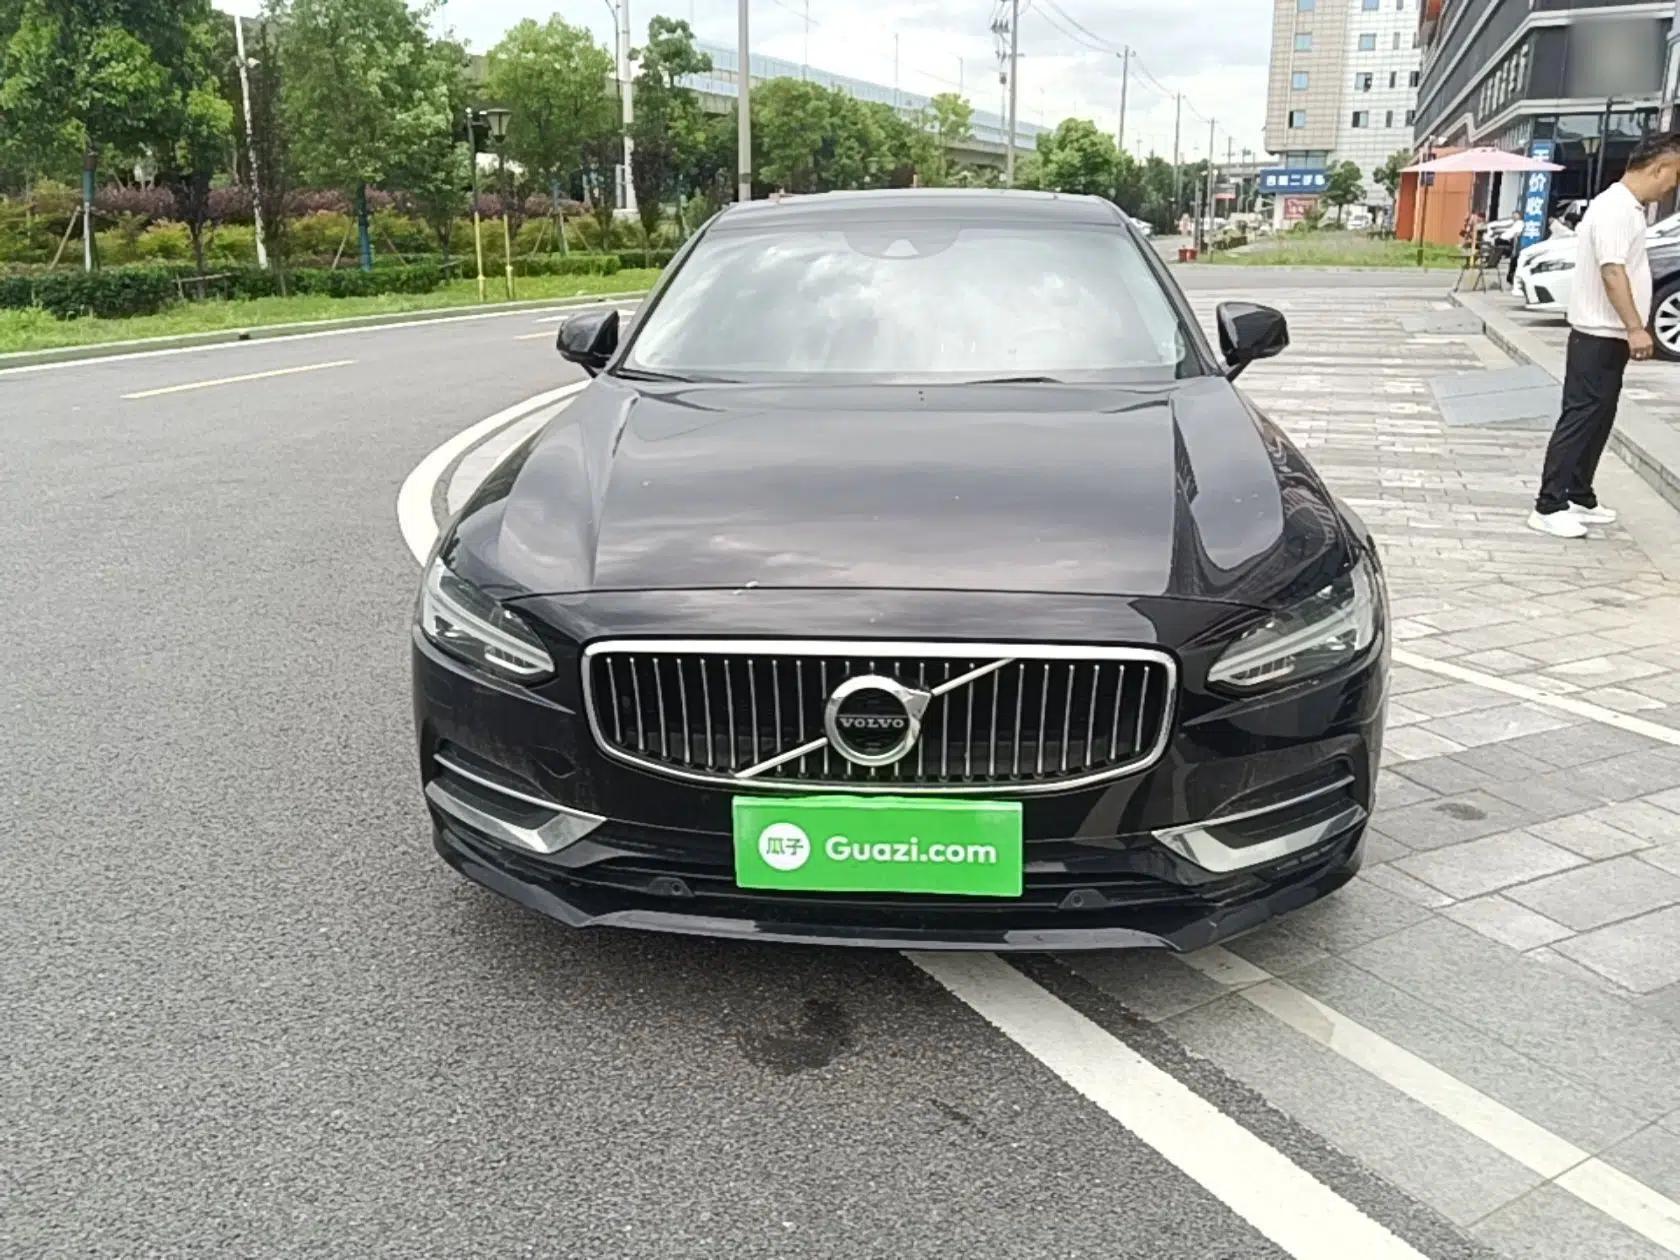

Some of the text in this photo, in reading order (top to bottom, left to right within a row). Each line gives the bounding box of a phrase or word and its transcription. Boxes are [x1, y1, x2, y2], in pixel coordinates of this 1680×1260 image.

[839, 717, 905, 729] VOLVO
[766, 836, 804, 857] 瓜子
[825, 835, 997, 864] Guazi.com
